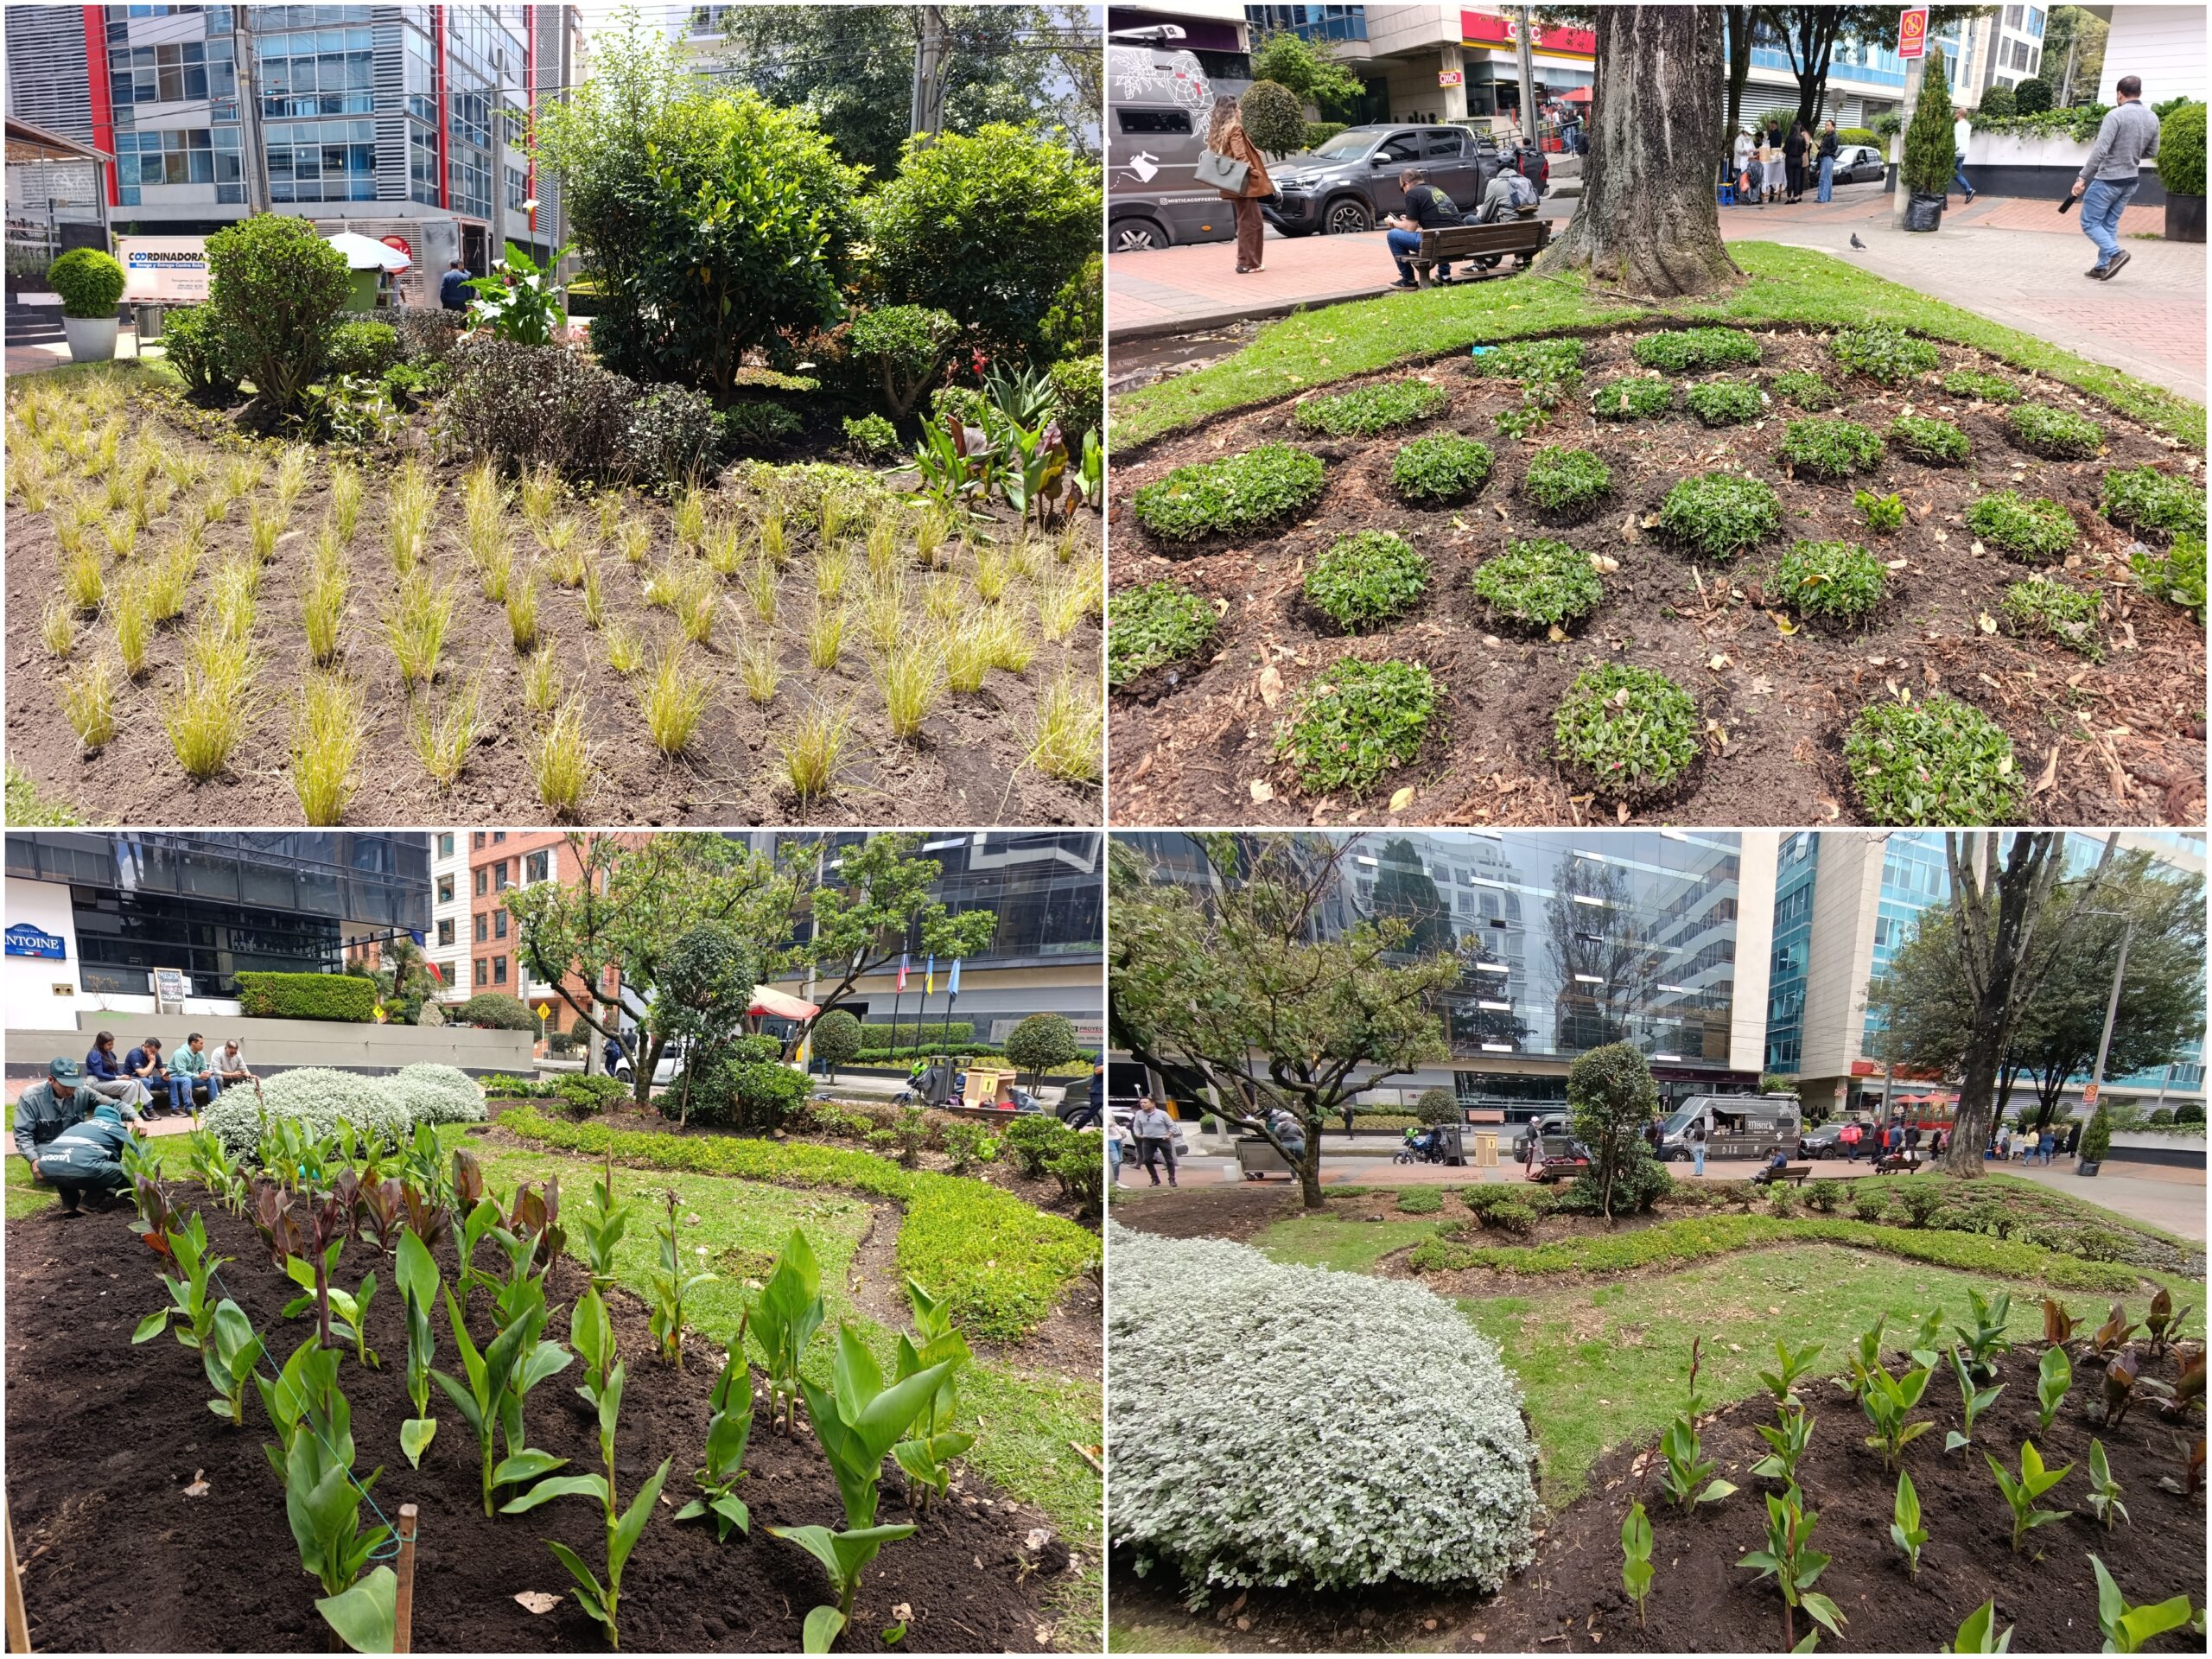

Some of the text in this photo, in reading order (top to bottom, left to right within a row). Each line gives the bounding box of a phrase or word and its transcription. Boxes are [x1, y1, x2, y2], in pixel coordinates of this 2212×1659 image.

[1440, 73, 1458, 84] OXXO
[129, 252, 206, 261] COORDINADORA
[5, 935, 60, 950] NTOINE
